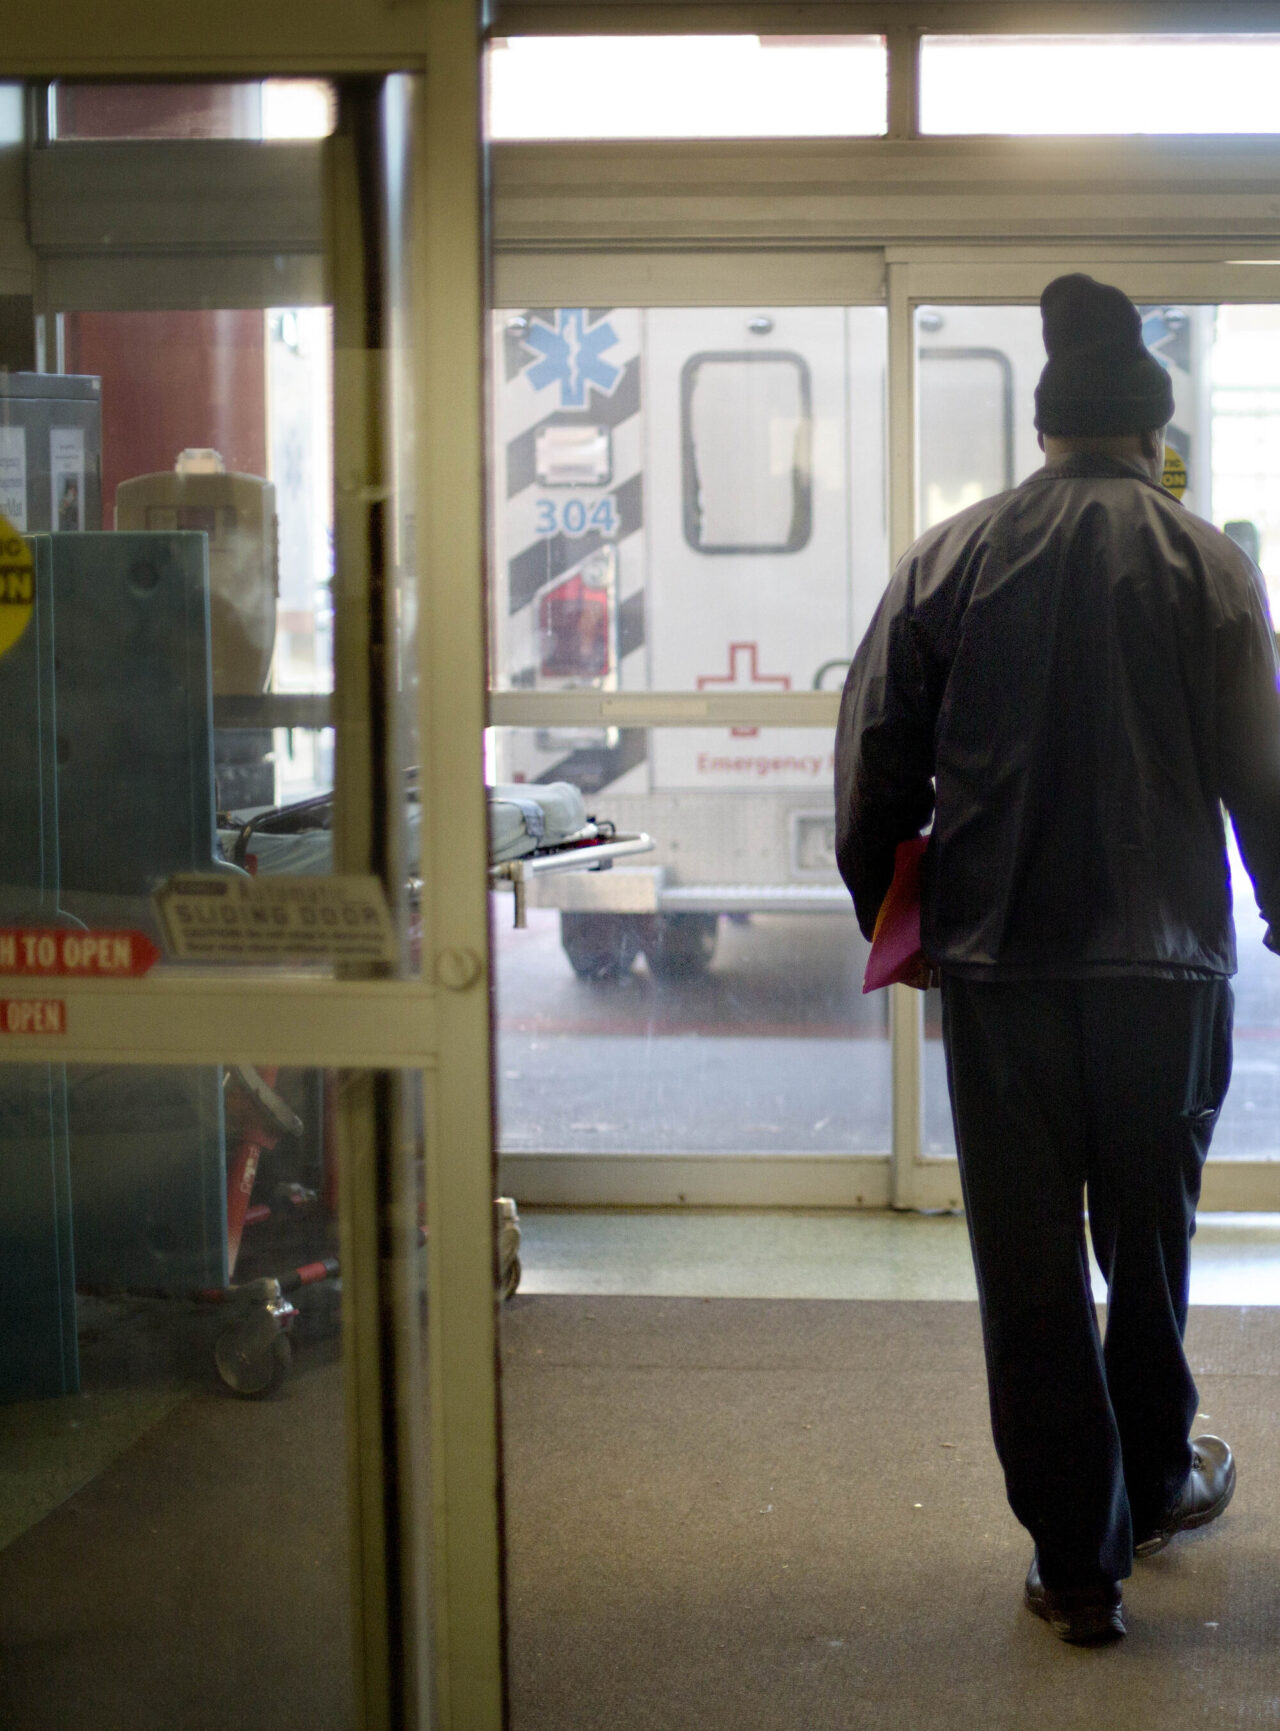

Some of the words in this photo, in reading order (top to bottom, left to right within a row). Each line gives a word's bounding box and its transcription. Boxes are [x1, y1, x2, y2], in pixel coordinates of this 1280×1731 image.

[535, 498, 616, 534] 304
[697, 752, 822, 777] Emergency
[22, 936, 56, 967] TO
[62, 936, 131, 968] OPEN
[7, 1002, 60, 1031] OPEN
